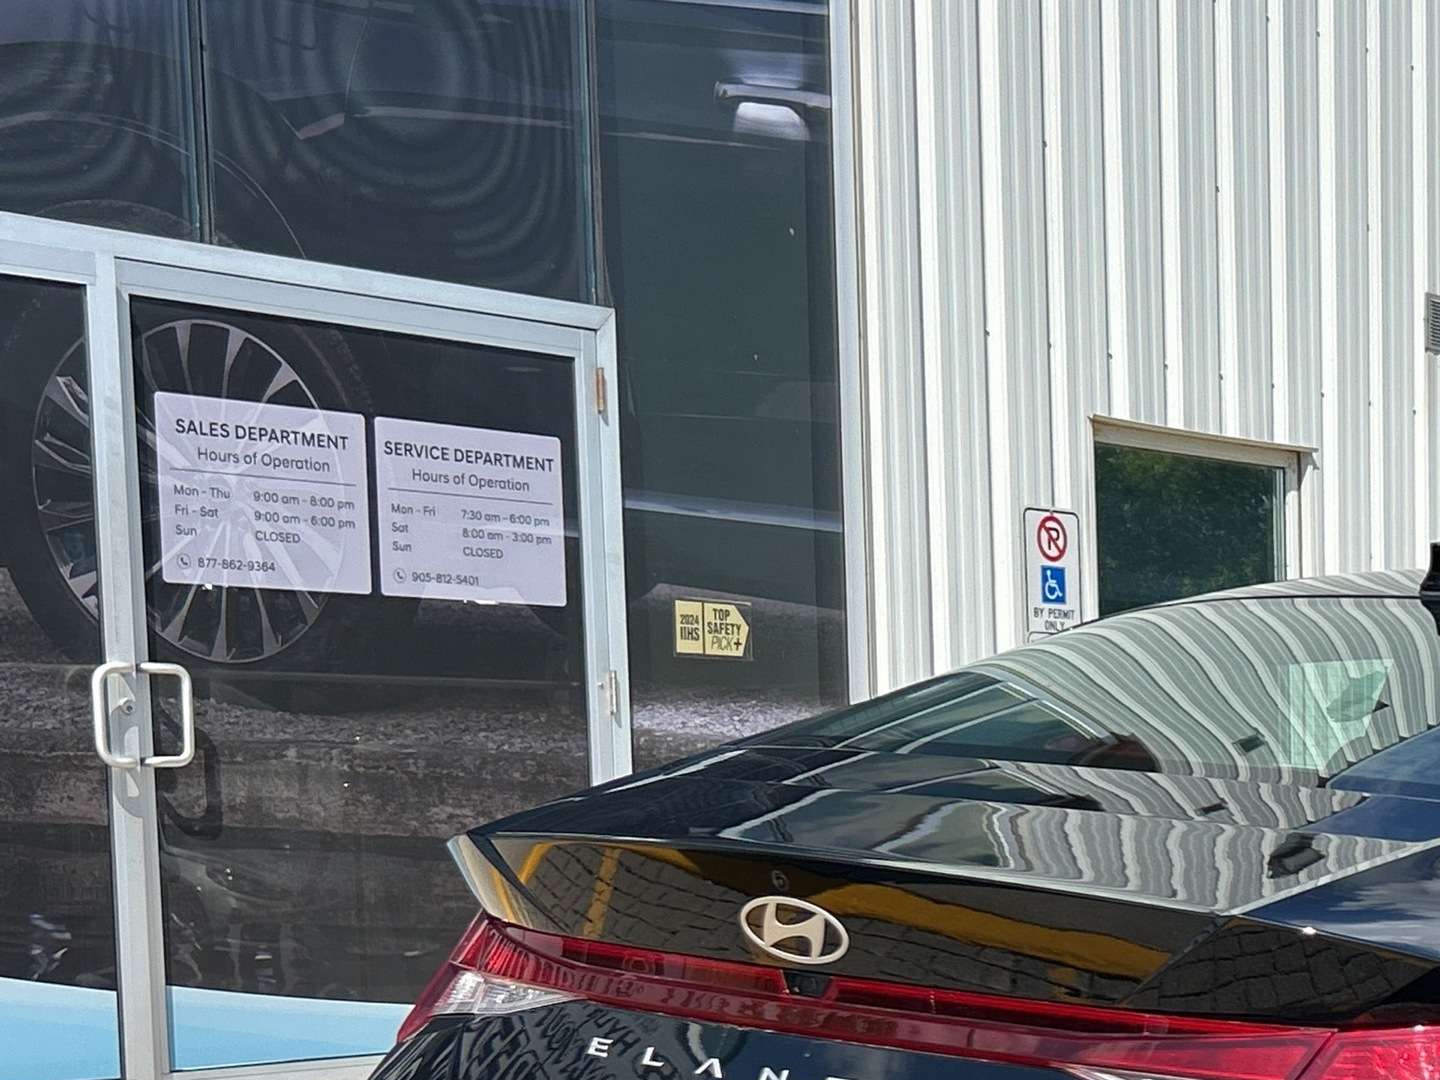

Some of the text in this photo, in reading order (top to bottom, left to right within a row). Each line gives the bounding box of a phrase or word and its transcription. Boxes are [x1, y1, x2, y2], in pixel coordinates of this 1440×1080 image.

[175, 418, 349, 450] SALES DEPARTMENT
[197, 447, 331, 473] Hours of Operation
[383, 440, 555, 472] SERVICE DEPARTMENT
[411, 468, 530, 492] Hours of Operation
[173, 484, 199, 497] Mon
[209, 486, 231, 500] Thu
[253, 490, 280, 504] 9:00
[281, 495, 300, 506] am
[309, 496, 335, 509] 8:00
[337, 499, 355, 512] pm
[174, 504, 189, 517] Fri
[199, 506, 219, 519] Sat
[253, 510, 280, 524] 9:00
[282, 514, 300, 525] am
[310, 515, 336, 528] 6:00
[337, 519, 356, 533] pm
[391, 503, 414, 516] Mon
[423, 505, 436, 517] Fri
[460, 508, 482, 521] 7:30
[483, 513, 501, 523] am
[509, 514, 532, 526] 6:00
[533, 517, 551, 528] pm
[175, 524, 301, 545] Sun CLOSED
[391, 521, 408, 534] Sat
[462, 528, 485, 540] 8:00
[486, 531, 504, 542] am
[511, 532, 534, 544] 3:00
[535, 535, 552, 546] pm
[392, 541, 504, 560] Sun CLOSED
[680, 614, 700, 626] 2024
[712, 608, 731, 621] TOP
[1033, 607, 1076, 620] BY PERMIT
[680, 626, 700, 641] IIHS
[707, 621, 742, 636] SAFETY
[1044, 620, 1065, 632] ONLY
